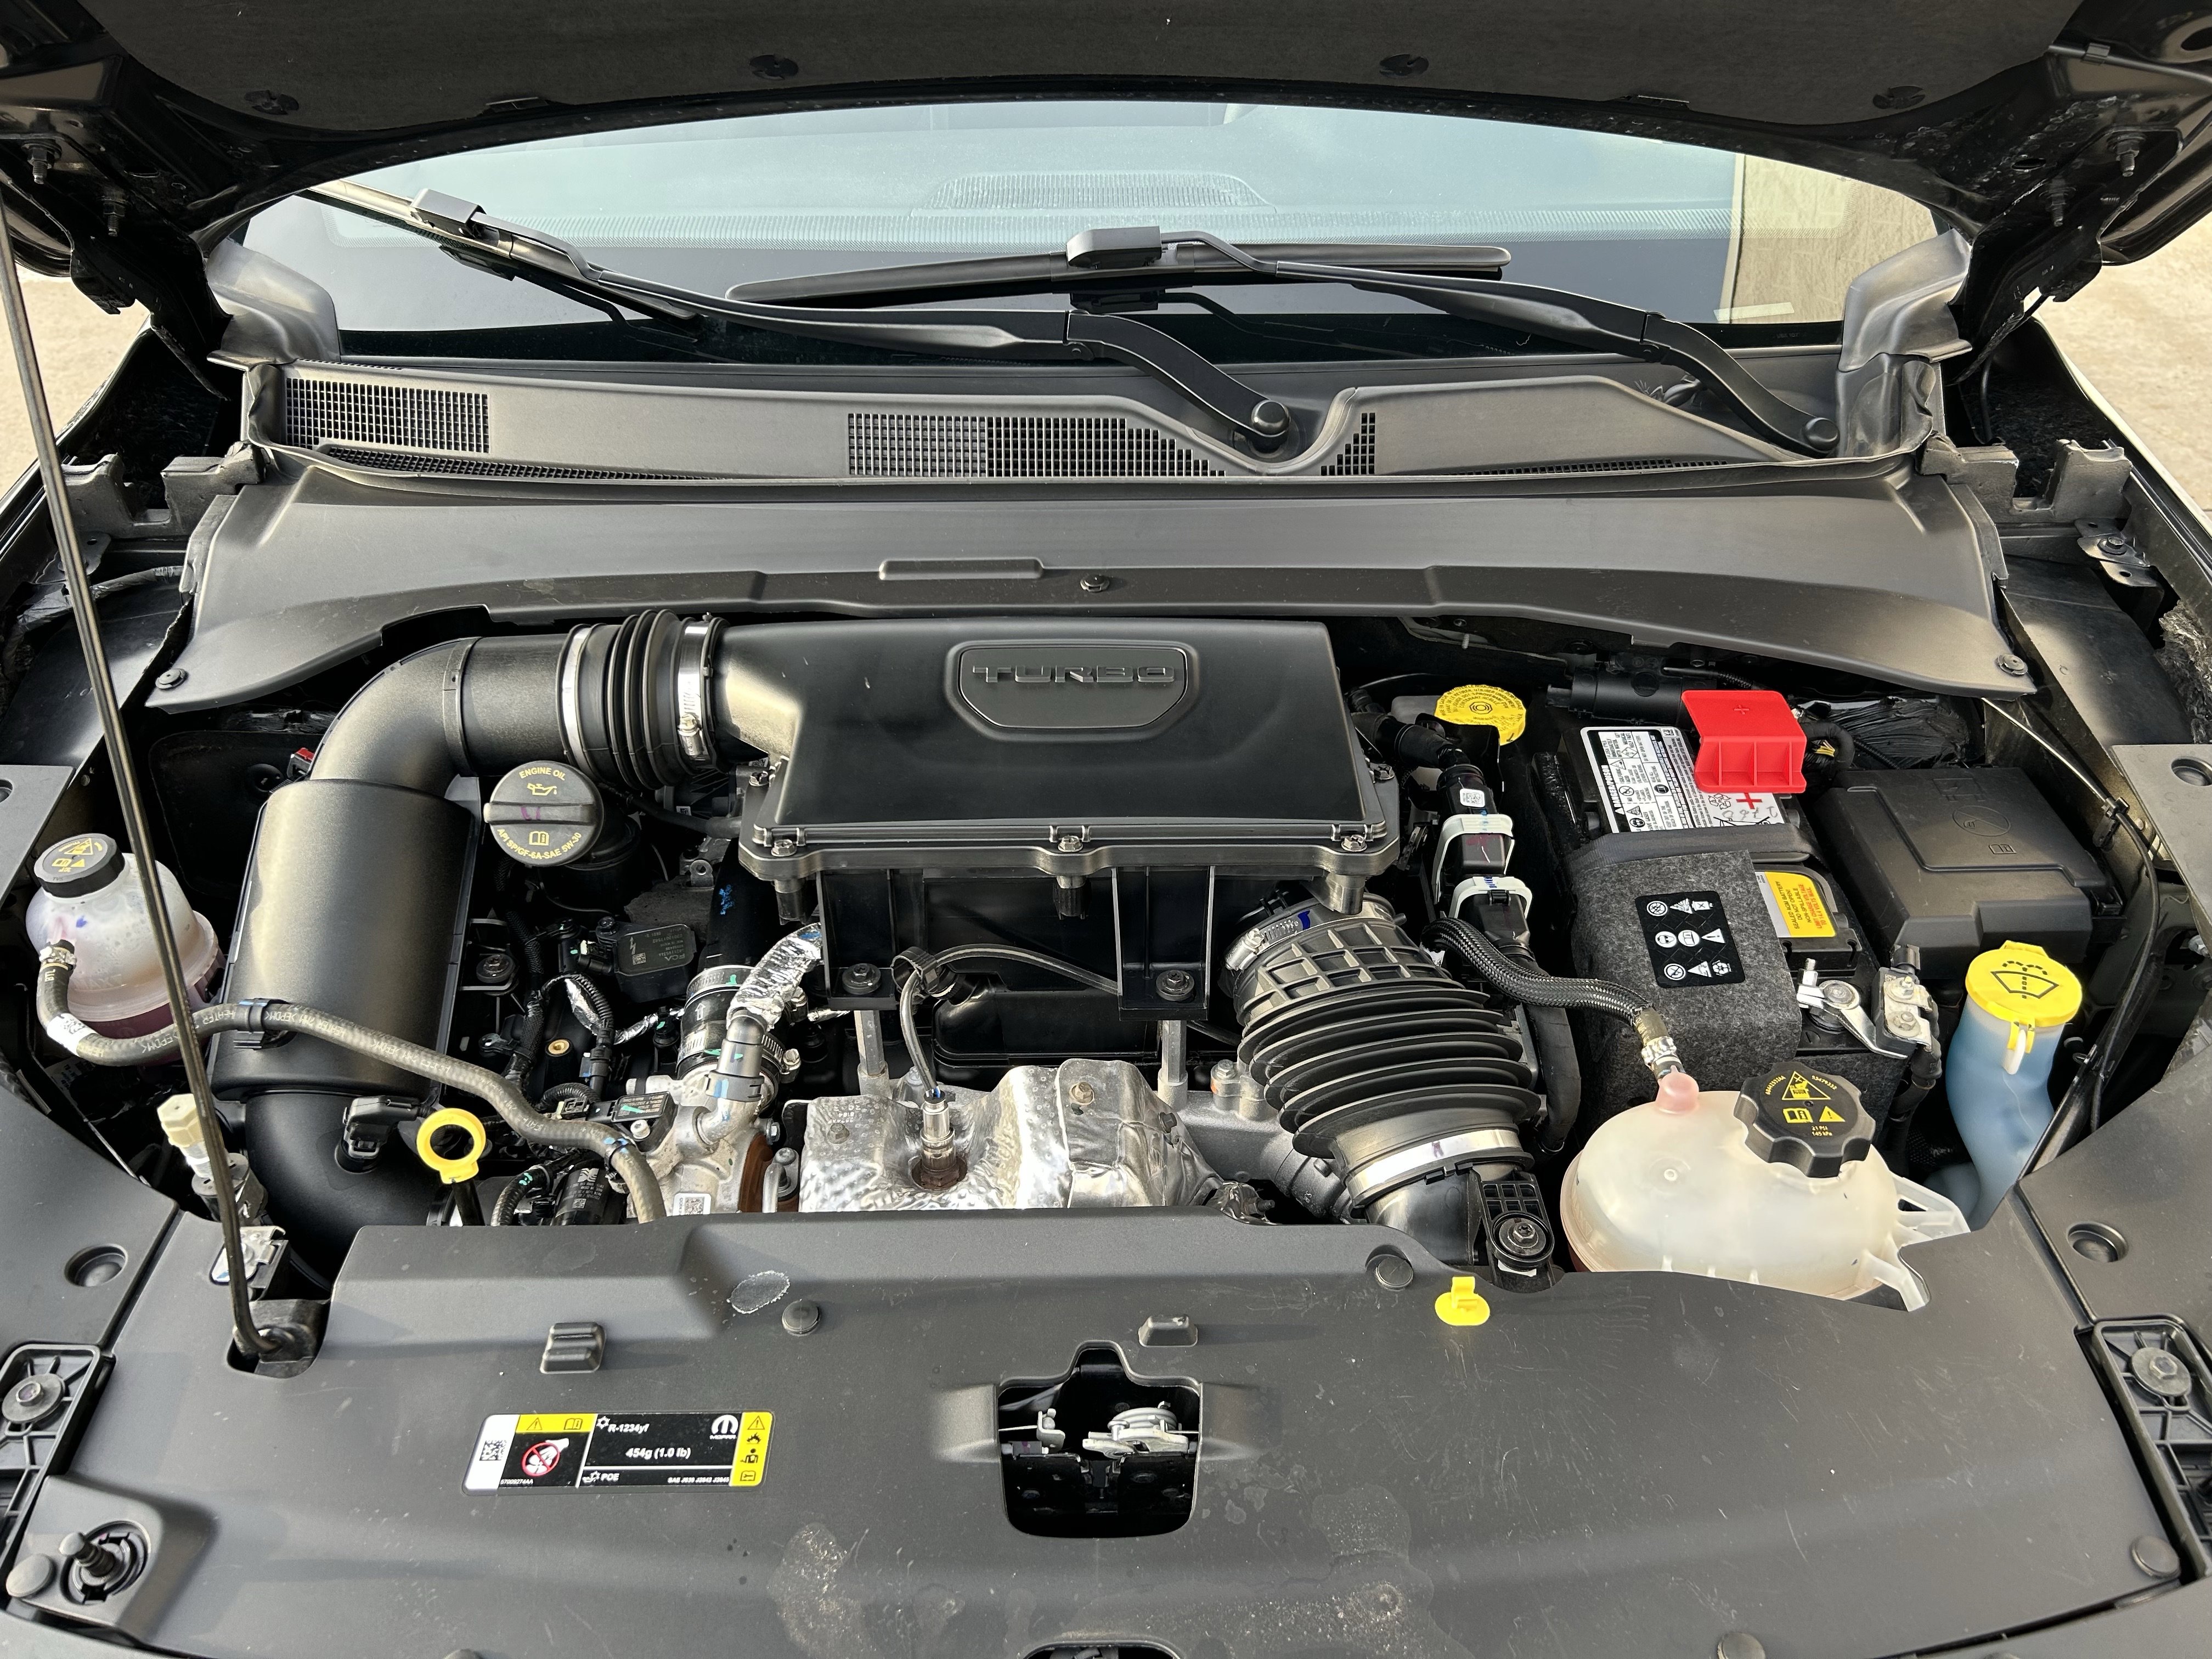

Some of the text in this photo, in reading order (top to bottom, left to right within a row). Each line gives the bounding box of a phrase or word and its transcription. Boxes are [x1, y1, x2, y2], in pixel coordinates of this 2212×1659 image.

[973, 665, 1175, 682] TURBO
[519, 767, 566, 781] ENGINE OIL
[497, 828, 507, 842] API
[561, 832, 582, 853] 5W-30
[1775, 881, 1799, 929] SEALED AGM BATTERY
[1791, 903, 1799, 912] NOT
[1792, 888, 1812, 922] NON-SPILLABLE
[1798, 884, 1822, 928] LIMIT CHARGE VOLTAGE
[1810, 897, 1820, 910] VOLTS
[44, 969, 55, 981] BTL
[315, 1020, 346, 1037] HEATER
[608, 1423, 650, 1434] R-1234yf
[625, 1447, 691, 1460] 454g (1.0 lb)
[601, 1473, 620, 1481] POE
